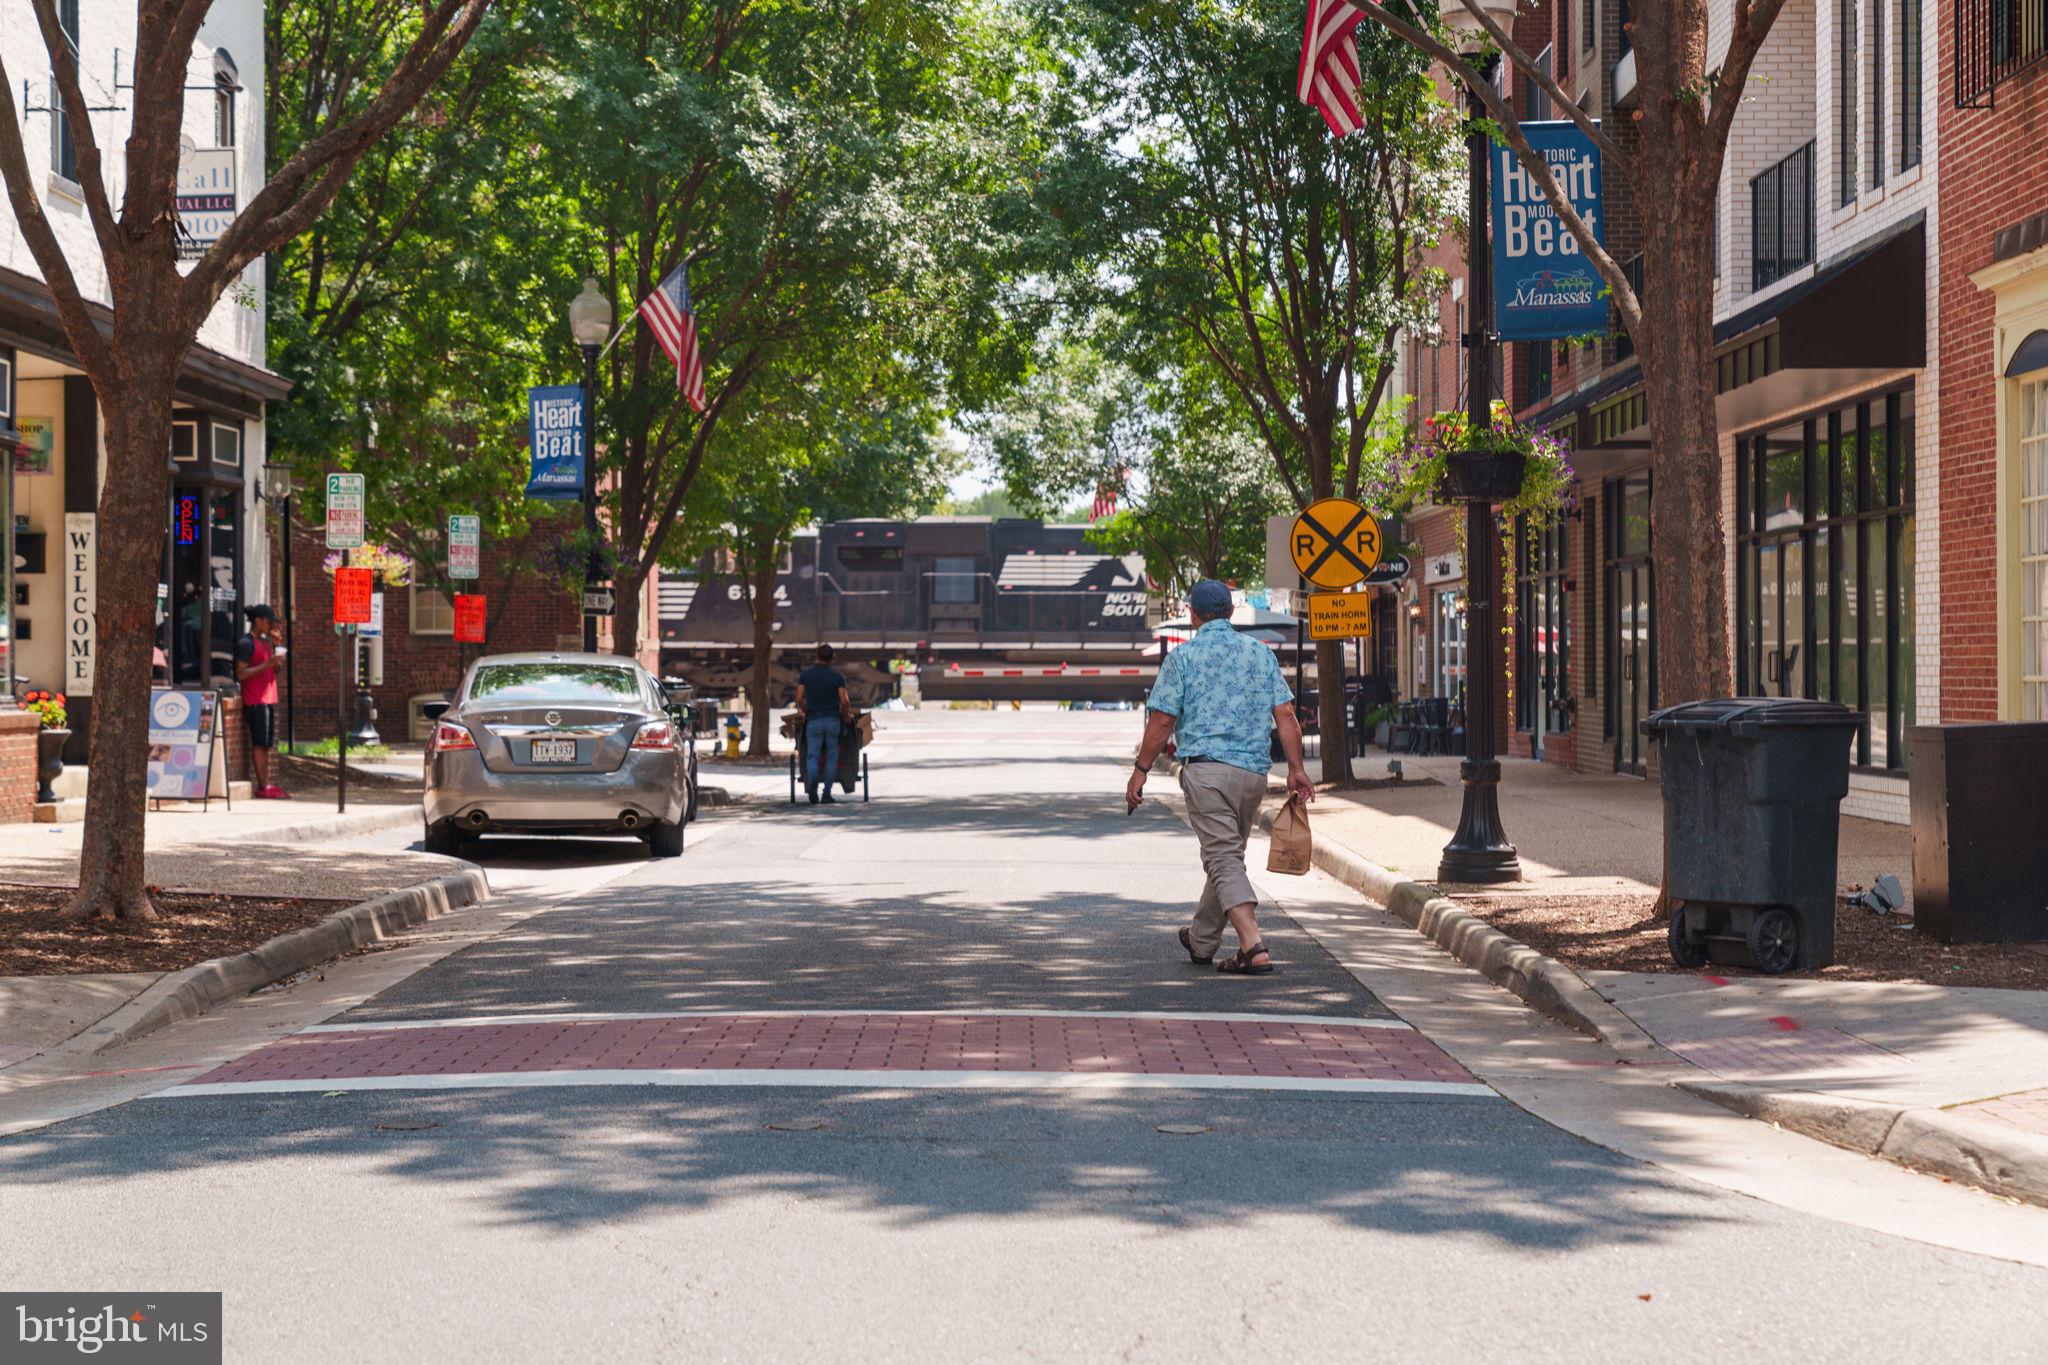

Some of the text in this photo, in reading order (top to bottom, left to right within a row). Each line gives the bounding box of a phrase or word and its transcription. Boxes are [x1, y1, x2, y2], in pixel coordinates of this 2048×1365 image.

[206, 197, 233, 209] LLC
[1528, 204, 1577, 218] MOD
[1512, 287, 1592, 307] Manassas
[534, 400, 582, 430] Heart
[536, 430, 582, 459] Beat
[330, 479, 338, 493] 2
[182, 499, 193, 542] OPEN
[1297, 531, 1376, 557] R R
[339, 579, 369, 587] PARKING
[69, 532, 91, 680] WELCOME
[1332, 599, 1346, 607] NO
[1314, 610, 1366, 620] TRAIN HORN
[1326, 624, 1339, 632] PM
[1346, 623, 1351, 631] 7
[1353, 623, 1367, 631] AM
